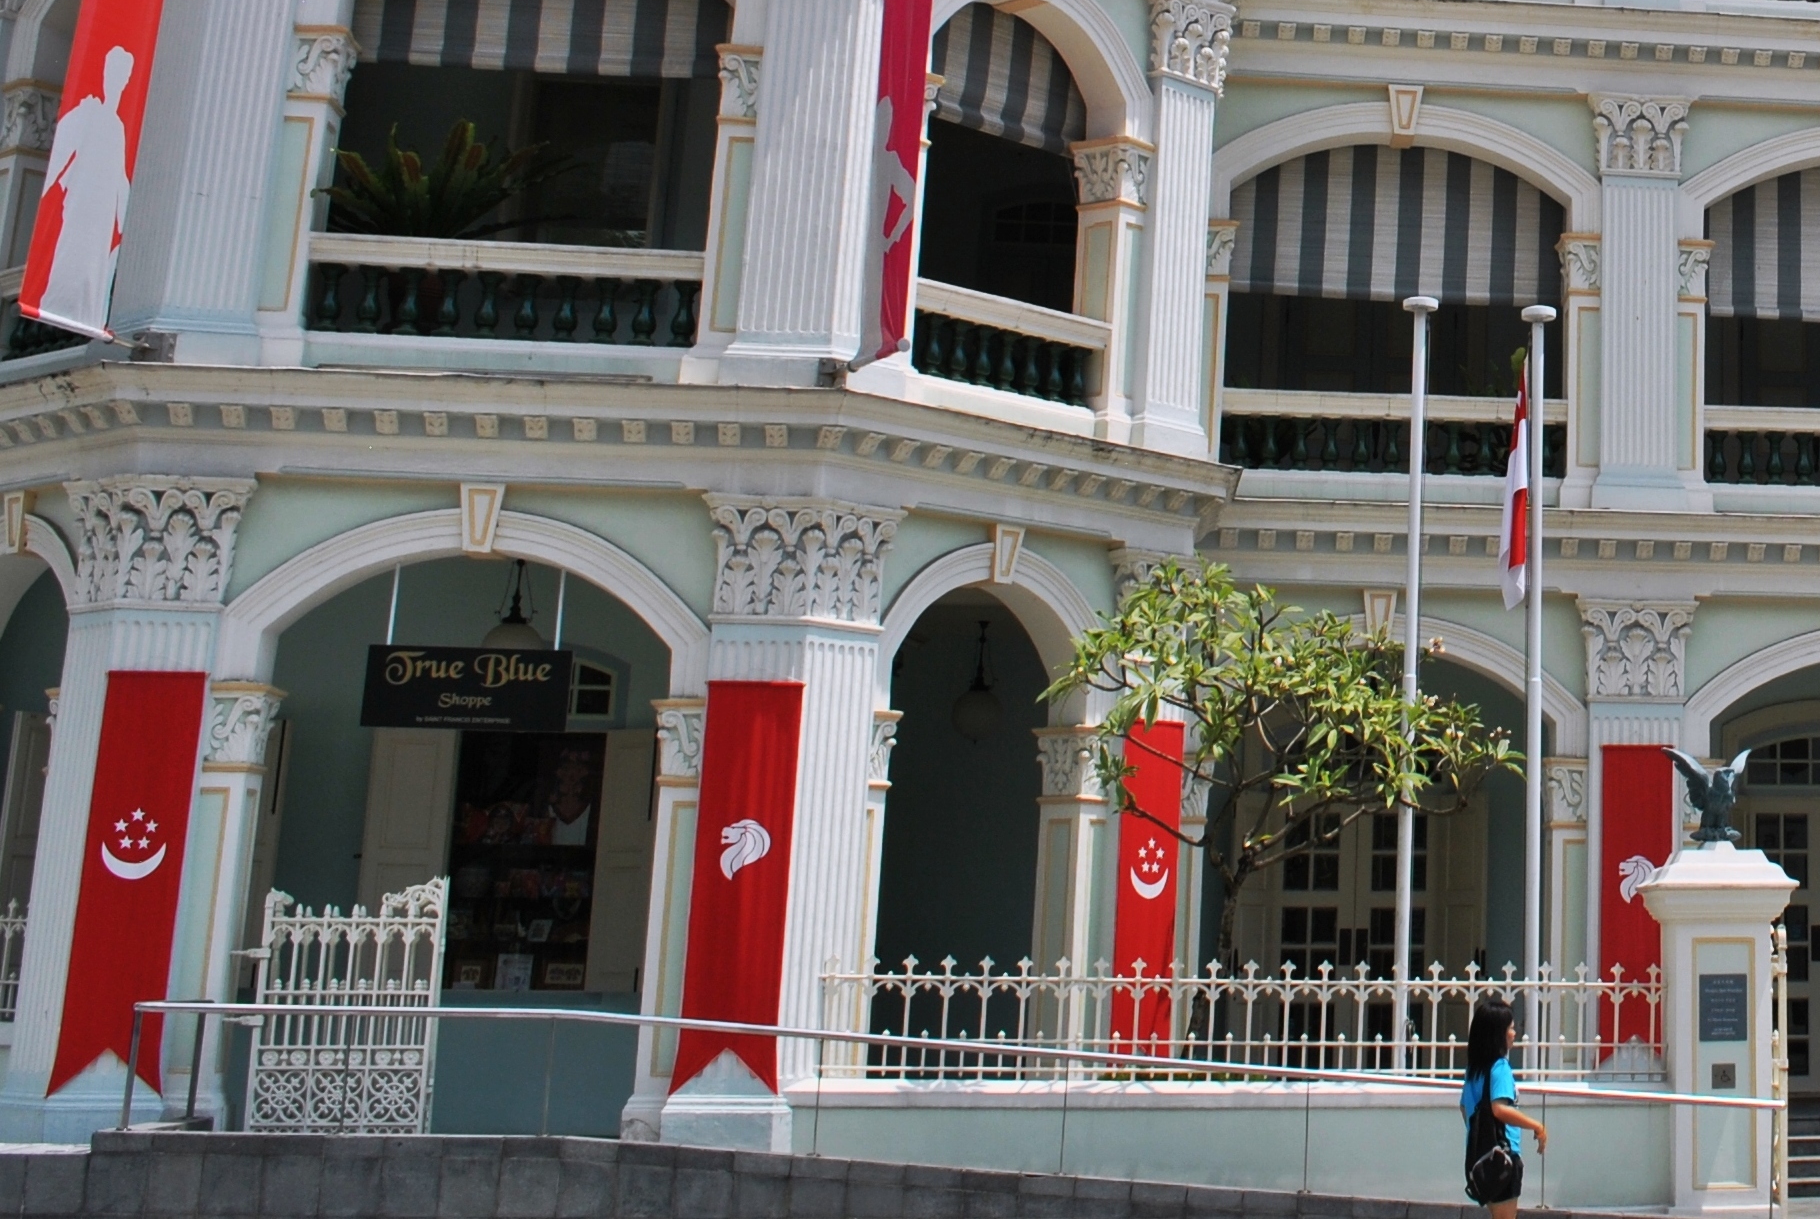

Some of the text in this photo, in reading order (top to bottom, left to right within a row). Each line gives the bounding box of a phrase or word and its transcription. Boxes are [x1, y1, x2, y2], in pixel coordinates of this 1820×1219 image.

[385, 651, 552, 688] True Blue
[438, 692, 492, 709] Shoppe
